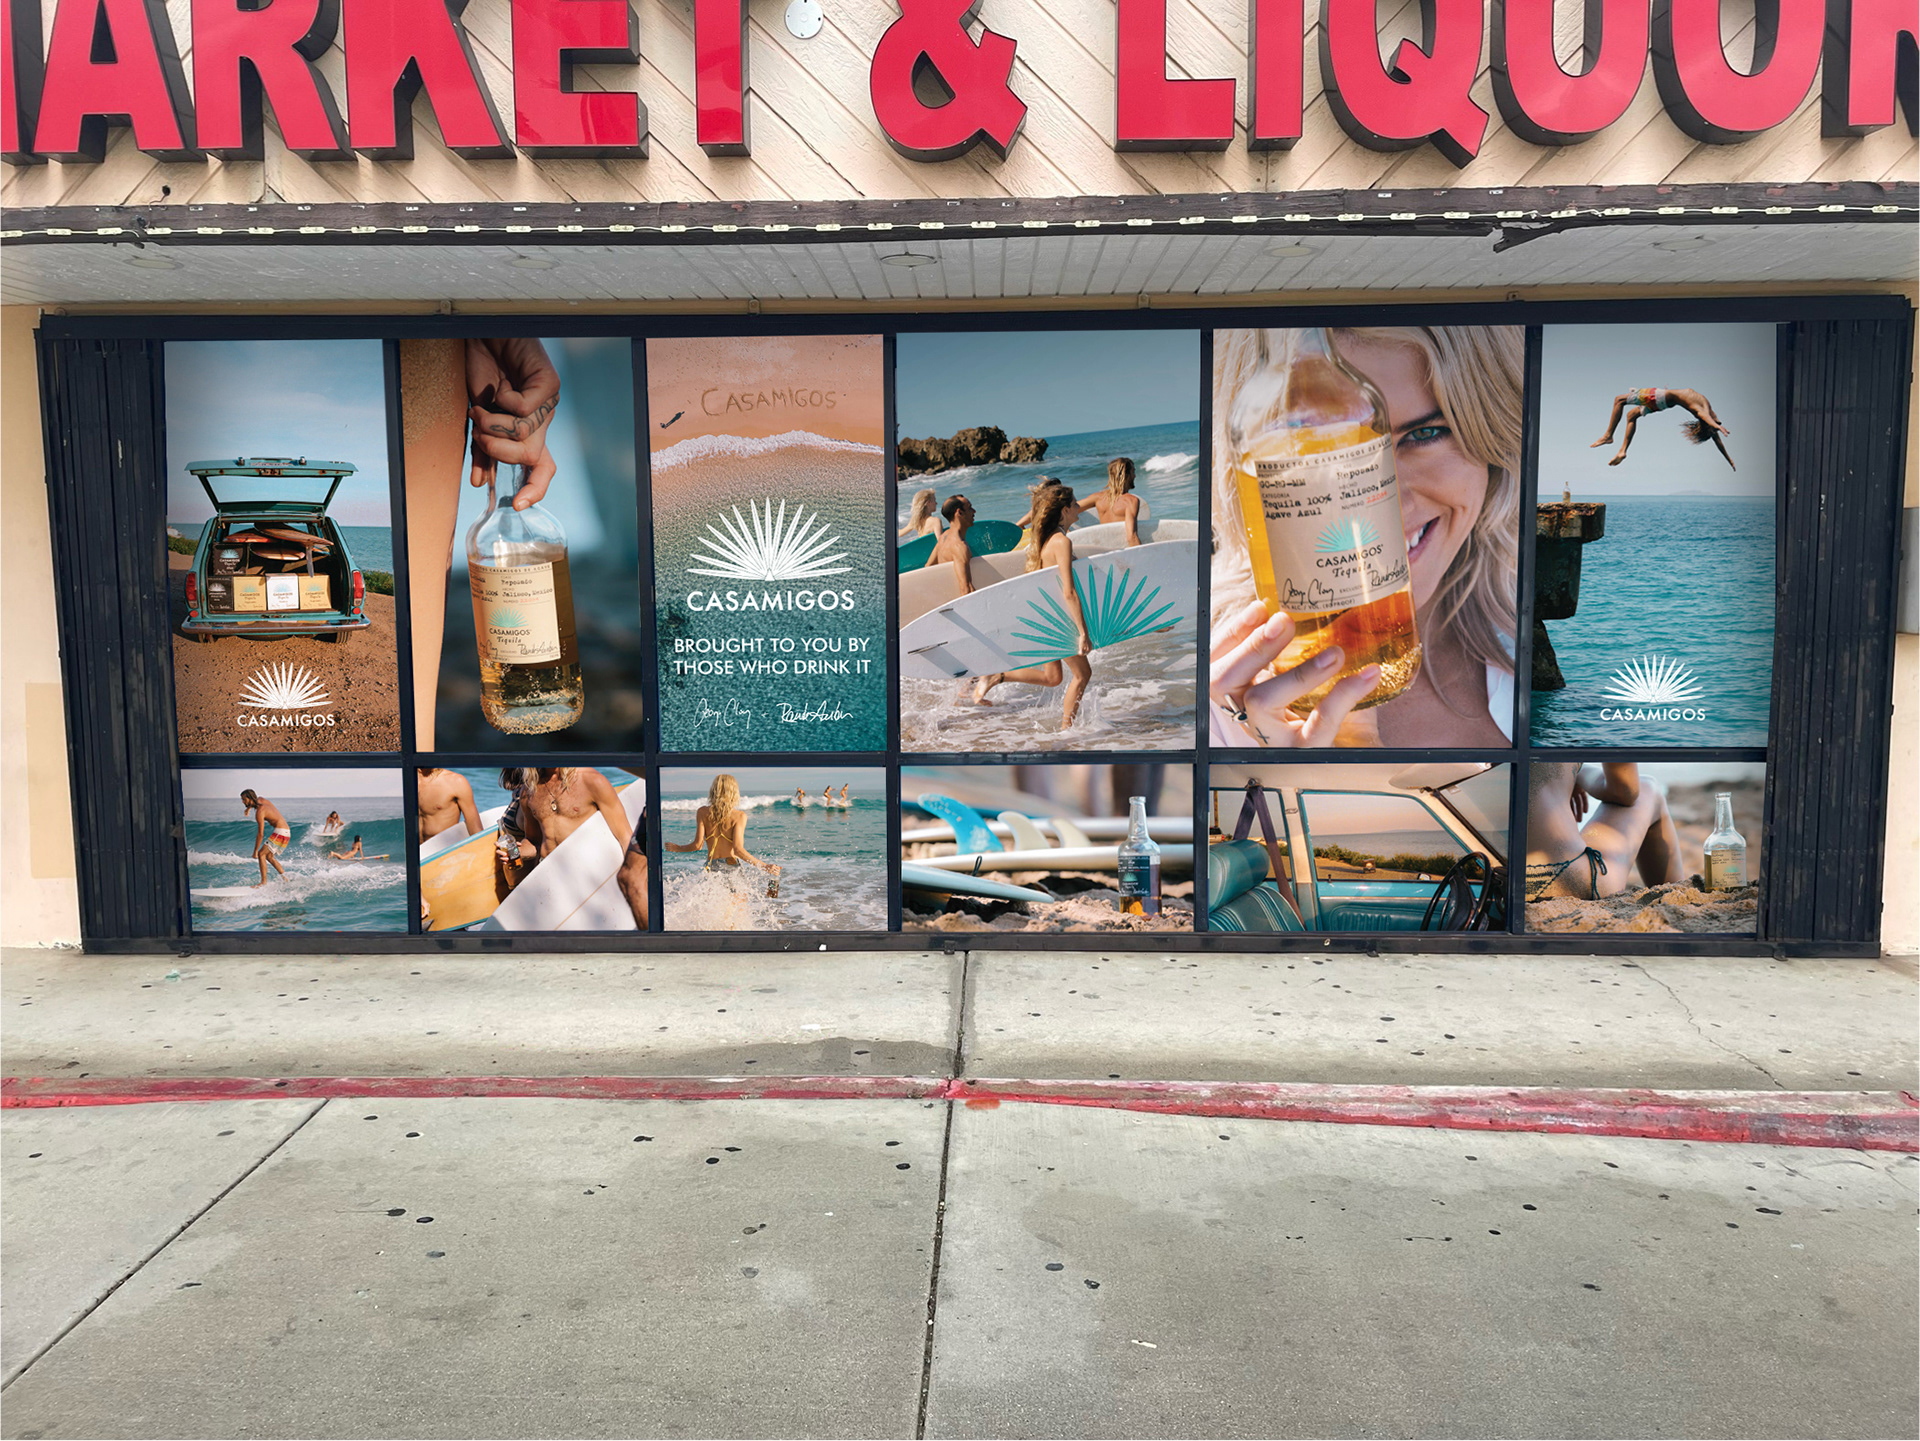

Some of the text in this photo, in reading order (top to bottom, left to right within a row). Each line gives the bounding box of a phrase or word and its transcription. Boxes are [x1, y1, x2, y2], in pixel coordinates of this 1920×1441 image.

[0, 0, 742, 155] ARKET
[870, 0, 1028, 155] &
[701, 386, 837, 416] CASAMIGOS
[1314, 449, 1365, 465] CASAMIGOS
[1336, 464, 1379, 480] Reposado
[1263, 494, 1332, 510] Tequila 100%
[1265, 508, 1322, 520] Agave Azul
[686, 590, 855, 611] CASAMIGOS
[489, 628, 531, 636] CASAMIGOS
[674, 637, 870, 653] BROUGHT TO YOU BY
[674, 659, 871, 674] THOSE WHO DRINK IT
[237, 714, 335, 727] CASAMIGOS
[1600, 708, 1706, 721] CASAMIGOS
